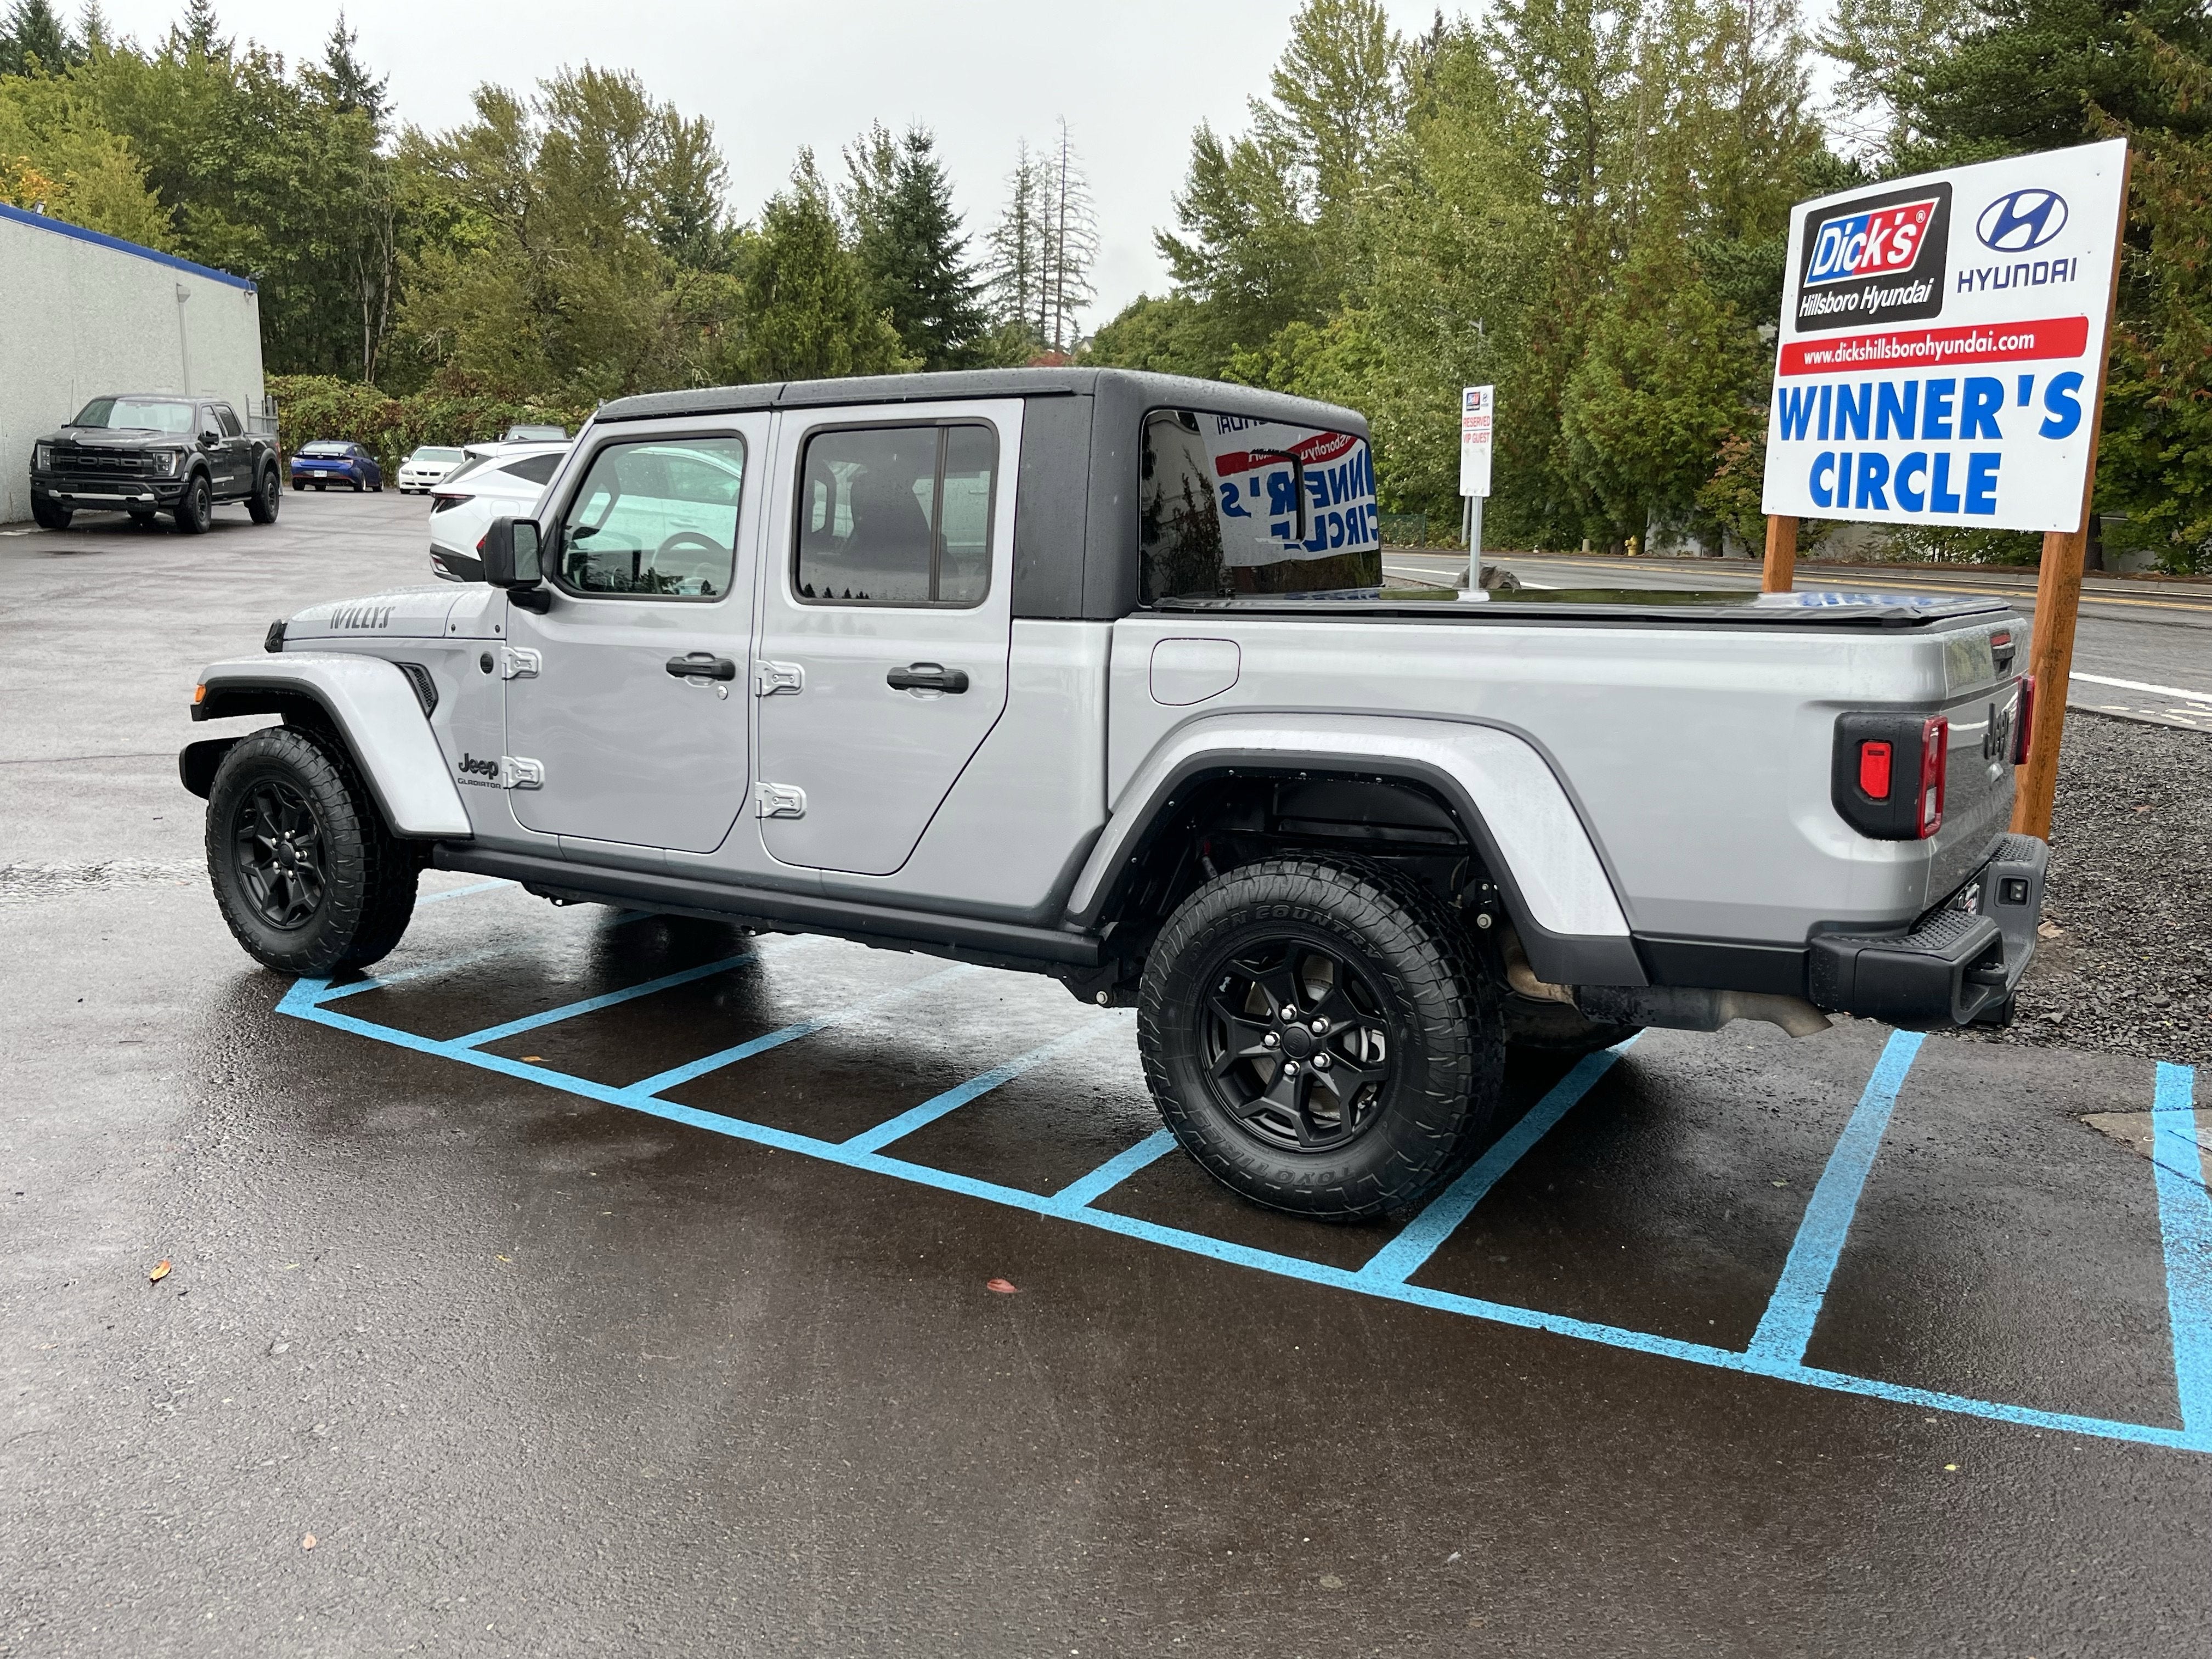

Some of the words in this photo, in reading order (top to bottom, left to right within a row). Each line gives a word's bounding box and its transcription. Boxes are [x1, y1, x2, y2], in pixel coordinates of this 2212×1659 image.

[1812, 212, 1917, 277] Dick's
[1956, 257, 2078, 294] HYUNDAI
[1798, 290, 1860, 318] Hillsboro
[1859, 277, 1935, 315] Hyundai
[1803, 330, 2035, 361] www.dickshillsborohyundai.com
[1778, 371, 2085, 441] WINNER'S
[1463, 416, 1491, 428] RESERVED
[1463, 433, 1471, 444] VIP
[1472, 432, 1491, 443] GUEST
[53, 455, 143, 467] FORD
[1809, 451, 2002, 515] CIRCLE
[330, 606, 396, 629] WILLYS
[458, 753, 499, 780] Jeep
[458, 778, 501, 789] GLADIATOR
[1255, 904, 1384, 960] COUNTRY
[1273, 1165, 1356, 1187] TOYO
